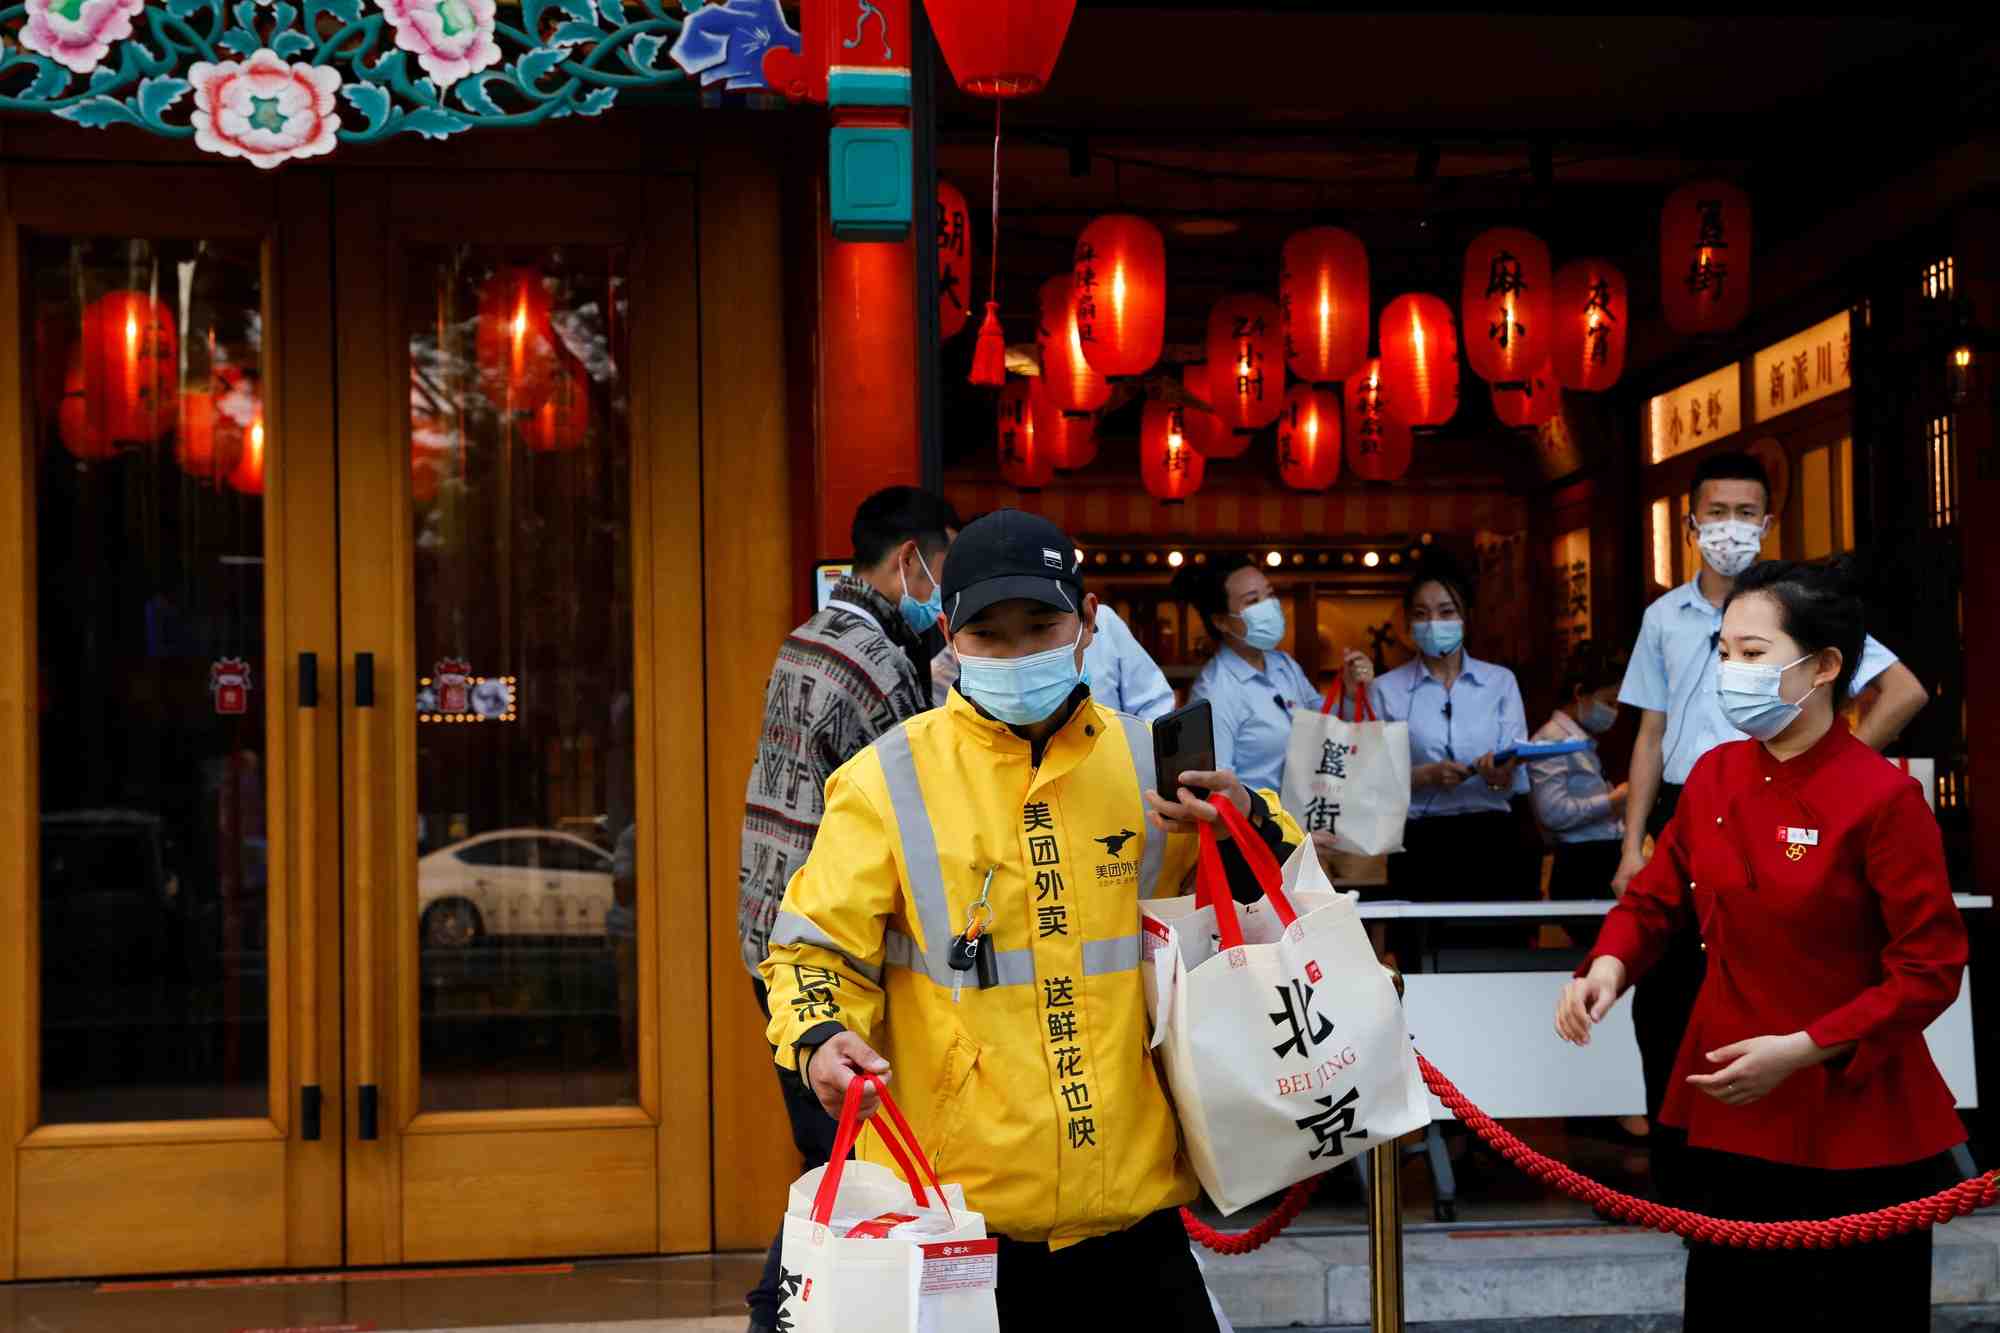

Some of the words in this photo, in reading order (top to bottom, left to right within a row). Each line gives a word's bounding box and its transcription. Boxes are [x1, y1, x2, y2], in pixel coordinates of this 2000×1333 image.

[1485, 250, 1528, 349] 麻小
[1304, 796, 1340, 835] 街
[1023, 801, 1068, 939] 美团外卖
[1043, 976, 1096, 1148] 送鲜花也快
[1269, 977, 1335, 1059] 北
[1296, 1087, 1369, 1160] 京
